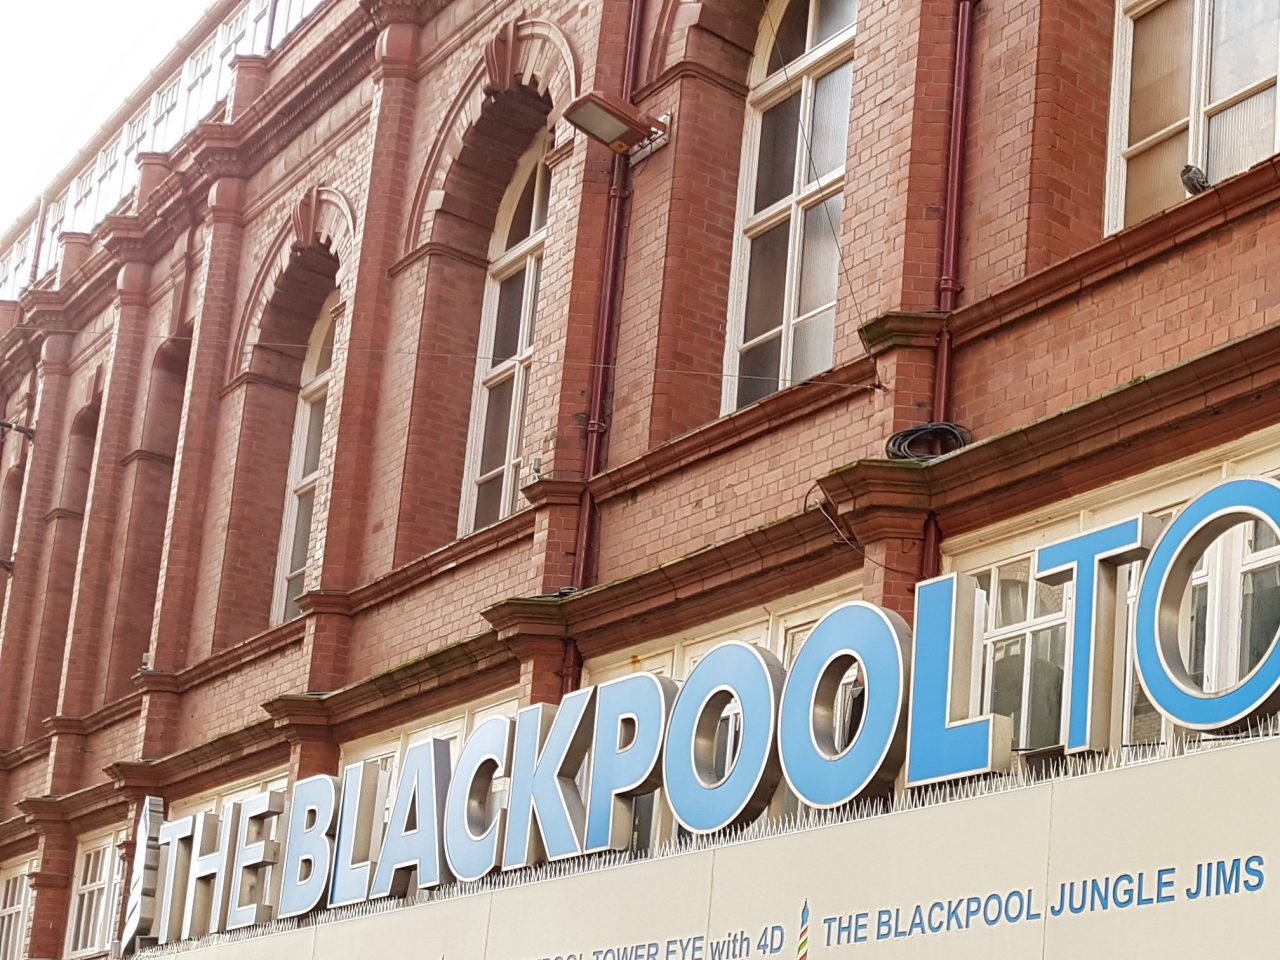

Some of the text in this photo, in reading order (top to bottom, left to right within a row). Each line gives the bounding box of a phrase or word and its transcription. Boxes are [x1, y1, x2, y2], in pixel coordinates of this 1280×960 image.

[157, 790, 282, 946] THE
[278, 572, 997, 918] BLACKPOOL
[756, 925, 785, 956] 4D
[823, 855, 1265, 946] THE BLACKPOOL JUNGLE JIMS
